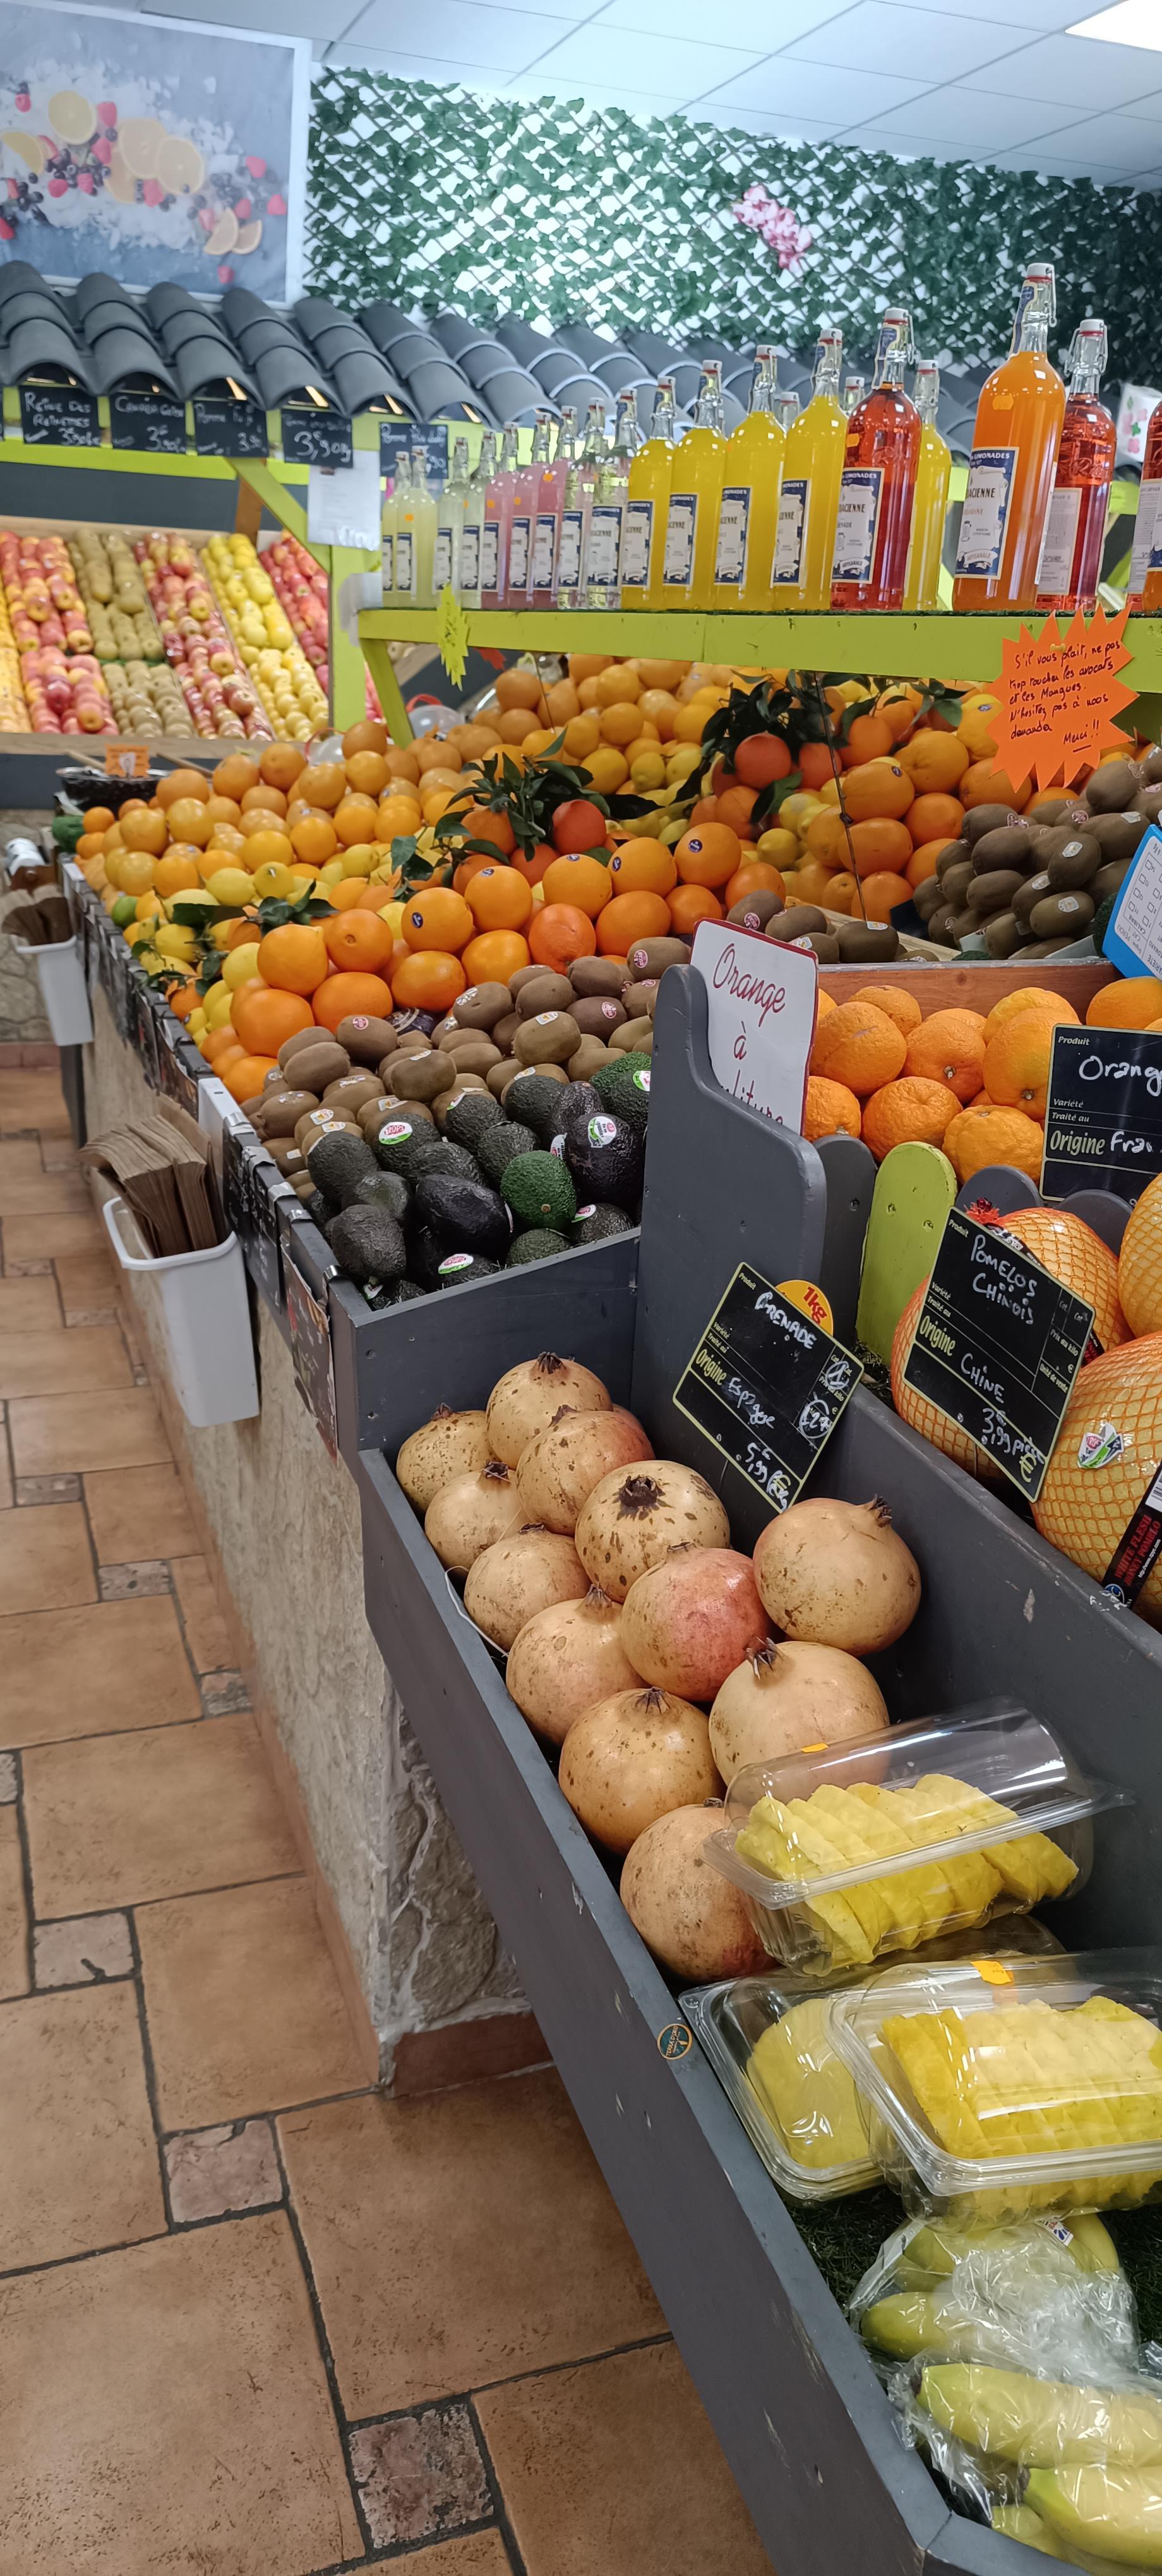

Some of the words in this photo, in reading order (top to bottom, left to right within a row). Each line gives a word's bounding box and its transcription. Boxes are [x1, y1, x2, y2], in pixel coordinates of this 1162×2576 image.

[1038, 654, 1057, 664] vous
[1091, 645, 1102, 654] ne
[1105, 640, 1120, 655] pas
[1063, 665, 1075, 681] les
[1079, 657, 1114, 676] avocats
[1021, 691, 1036, 703] les
[1051, 701, 1068, 718] pas
[1072, 695, 1081, 708] à
[1128, 914, 1146, 935] CALIBRE
[713, 943, 786, 1027] Orange
[734, 1020, 746, 1060] à
[1058, 1035, 1090, 1046] Produit
[1053, 1097, 1084, 1108] Variété
[1051, 1111, 1077, 1122] Traité
[1050, 1130, 1106, 1156] Origine
[947, 1219, 969, 1238] Produit
[970, 1234, 1038, 1297] POMELOS
[738, 1272, 757, 1291] Produit
[931, 1281, 951, 1301] Variété
[803, 1286, 827, 1325] 1kg
[926, 1294, 942, 1313] Traité
[942, 1306, 951, 1318] au
[714, 1321, 731, 1339] Variété
[754, 1291, 818, 1349] GRENADE
[707, 1332, 721, 1348] Traité
[919, 1314, 956, 1357] Origine
[1050, 1328, 1061, 1342] Prix
[1060, 1338, 1069, 1349] au
[1067, 1343, 1079, 1357] kilo
[695, 1349, 727, 1386] Origine
[960, 1352, 1005, 1404] CHINE
[1067, 1363, 1074, 1374] €
[1049, 1373, 1057, 1383] de
[1055, 1378, 1069, 1393] vente
[834, 1390, 844, 1402] kilo
[832, 1407, 839, 1415] €
[1019, 1452, 1037, 1482] €
[1114, 1546, 1136, 1578] WHITE
[1130, 1515, 1153, 1549] FLESH
[1137, 1520, 1161, 1559] POMELO
